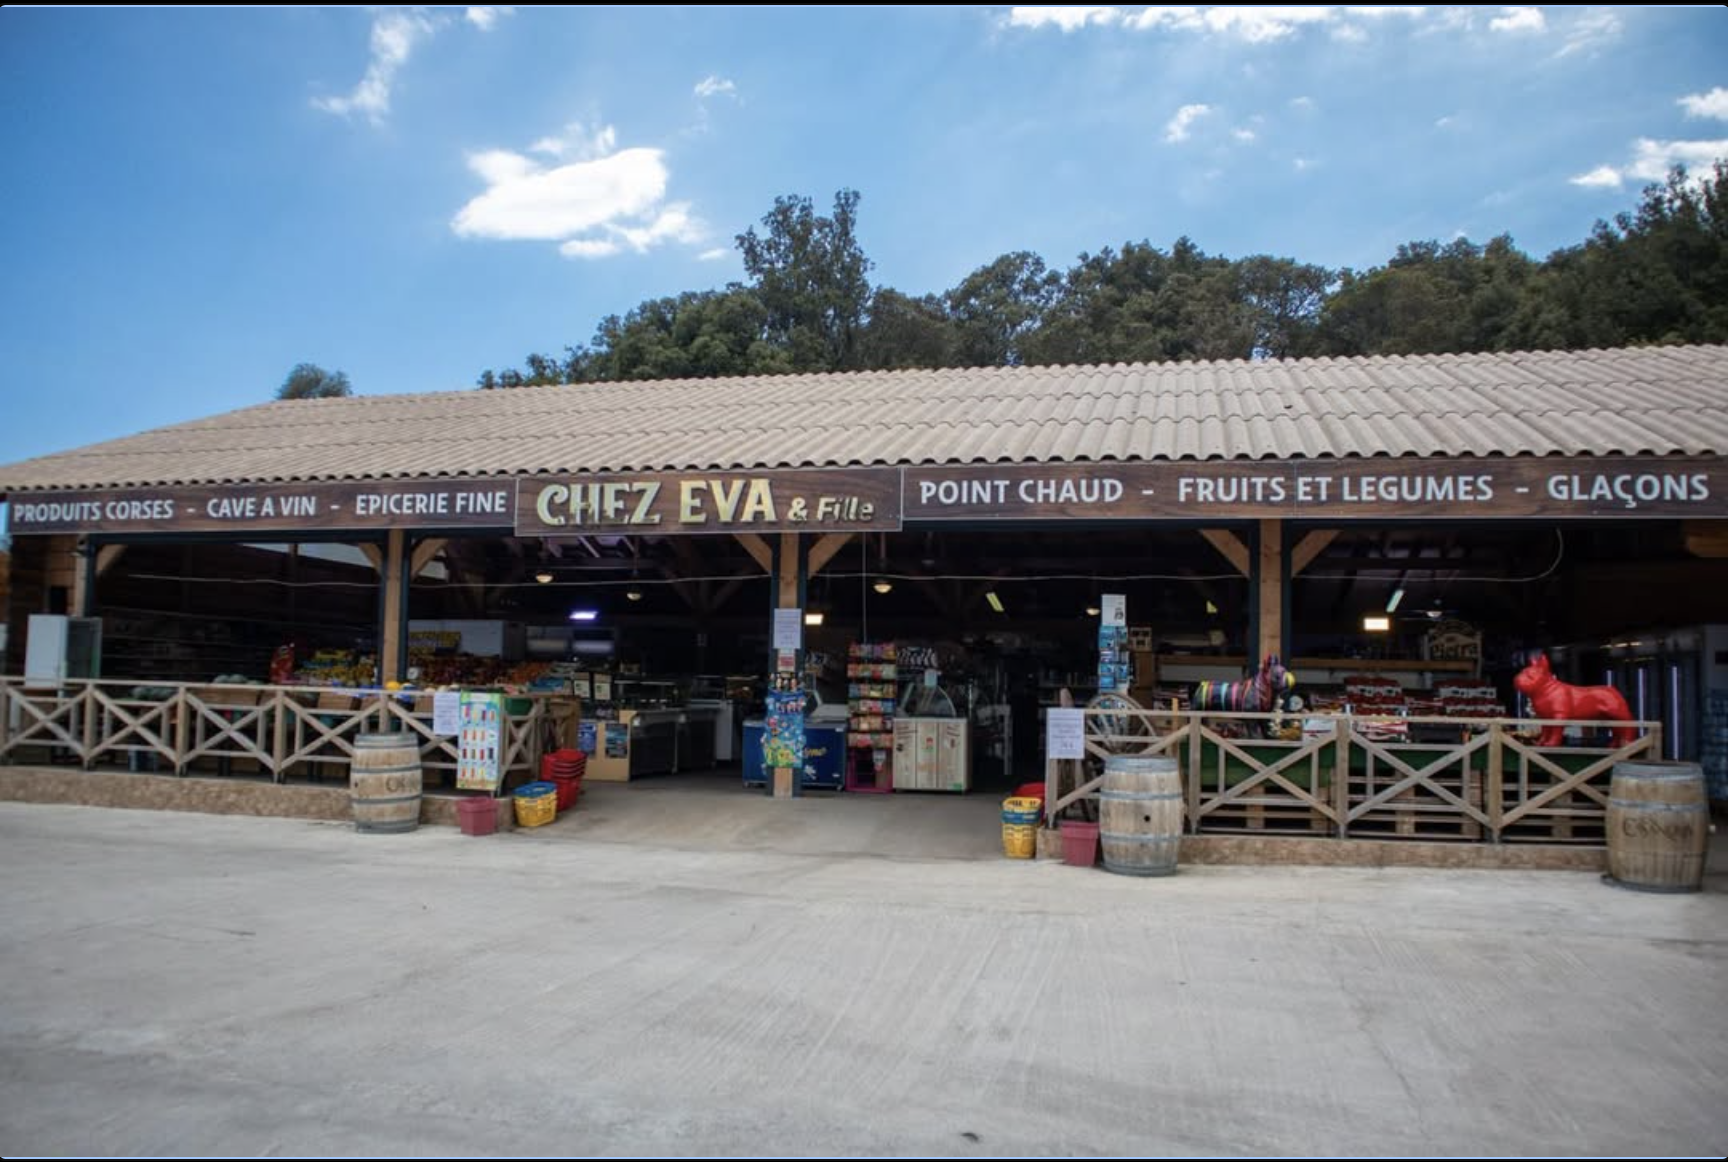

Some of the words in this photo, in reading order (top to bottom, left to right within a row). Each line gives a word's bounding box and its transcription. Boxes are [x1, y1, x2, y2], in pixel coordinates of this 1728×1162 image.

[13, 502, 101, 522] PRODUITS
[105, 500, 174, 520] CORSES
[206, 498, 256, 518] CAVE
[260, 497, 275, 517] A
[279, 496, 316, 516] VIN
[355, 493, 449, 515] EPICERIE
[455, 492, 507, 514] FINE
[536, 481, 662, 526] CHEZ
[678, 478, 778, 525] EVA
[787, 497, 809, 522] &
[816, 496, 876, 522] Fille
[919, 480, 1010, 504] POINT
[1018, 479, 1124, 504] CHAUD
[1178, 477, 1286, 502] FRUITS
[1297, 476, 1332, 500] ET
[1342, 475, 1494, 500] LEGUMES
[1547, 474, 1710, 508] GLAÇONS
